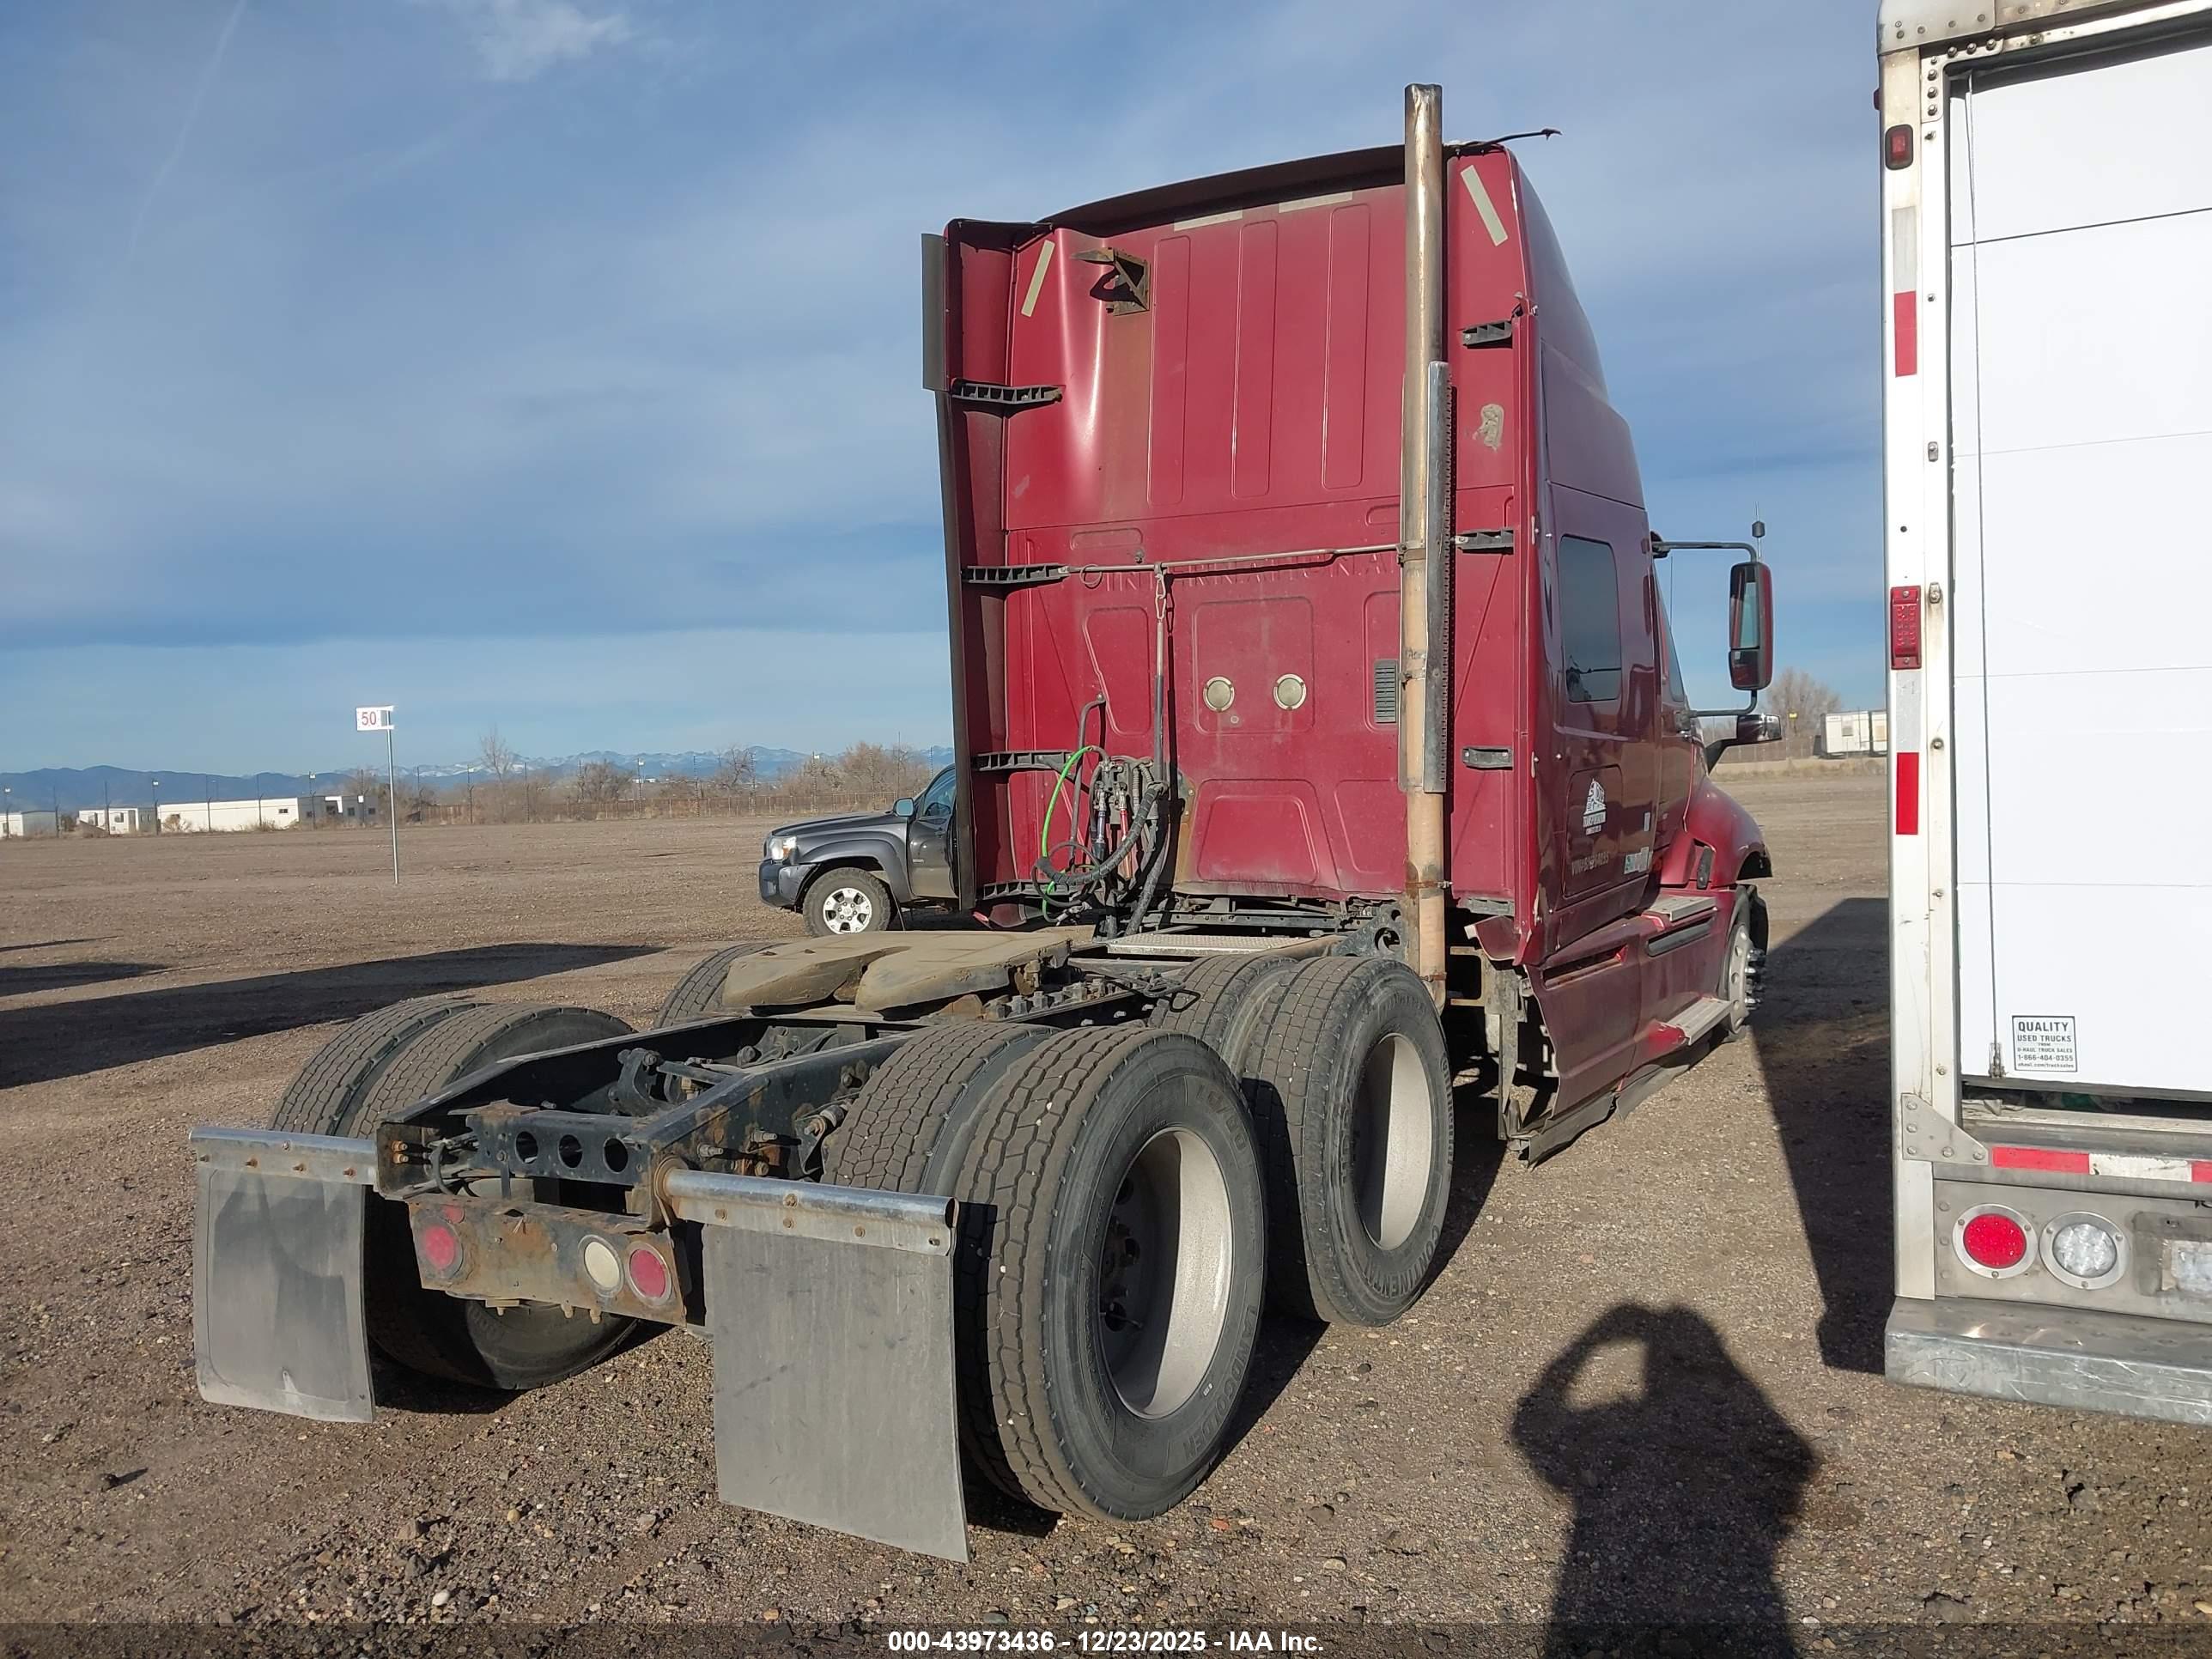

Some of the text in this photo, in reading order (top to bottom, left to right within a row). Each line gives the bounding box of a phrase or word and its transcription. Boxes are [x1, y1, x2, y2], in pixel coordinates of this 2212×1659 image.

[362, 711, 377, 726] 50
[2018, 1021, 2069, 1033] QUALITY
[1364, 1224, 1442, 1299] CONTINENTAL
